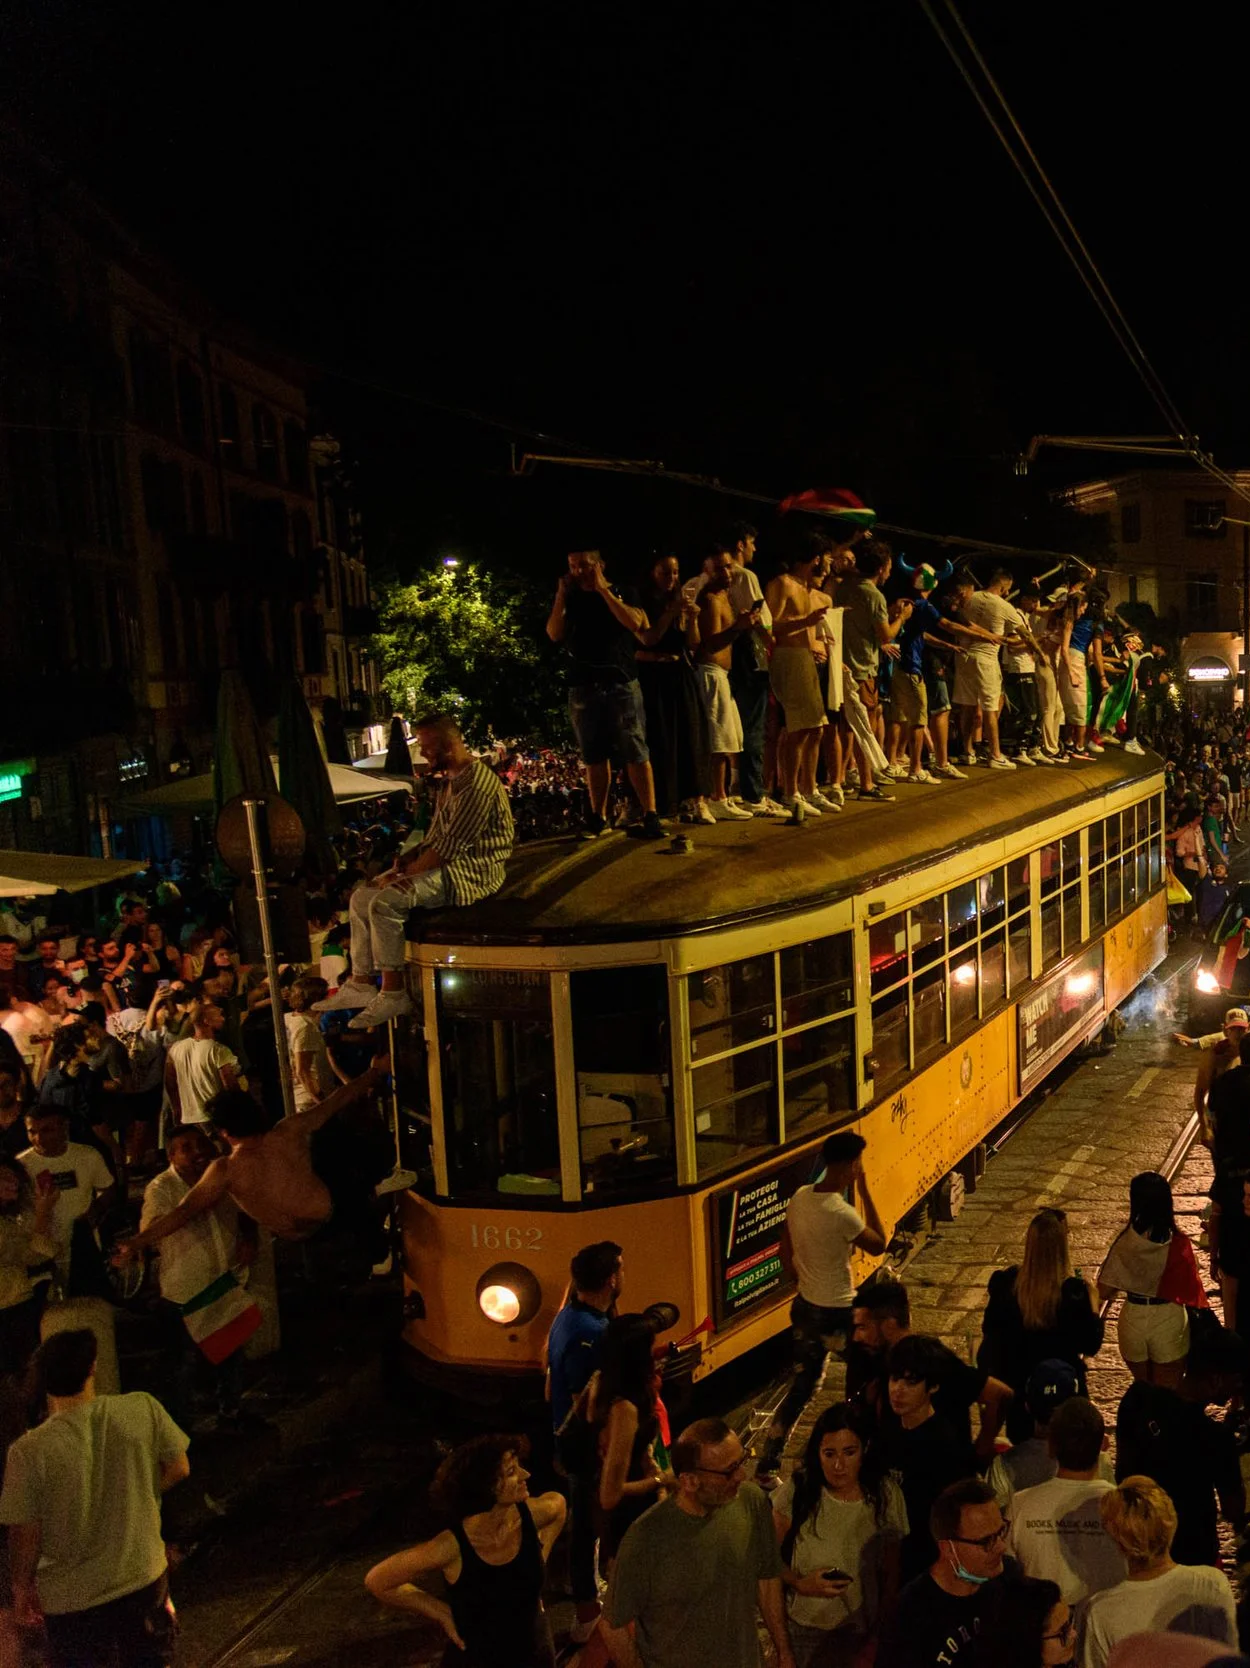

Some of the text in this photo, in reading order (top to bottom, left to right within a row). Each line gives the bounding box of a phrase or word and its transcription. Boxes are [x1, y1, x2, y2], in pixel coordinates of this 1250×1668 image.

[740, 1180, 779, 1206] PROTEGGI
[756, 1193, 778, 1210] CASA
[758, 1212, 787, 1234] AZIEND
[470, 1224, 543, 1251] 1662
[738, 1275, 755, 1290] 800
[755, 1265, 769, 1281] 327
[769, 1258, 781, 1272] 311
